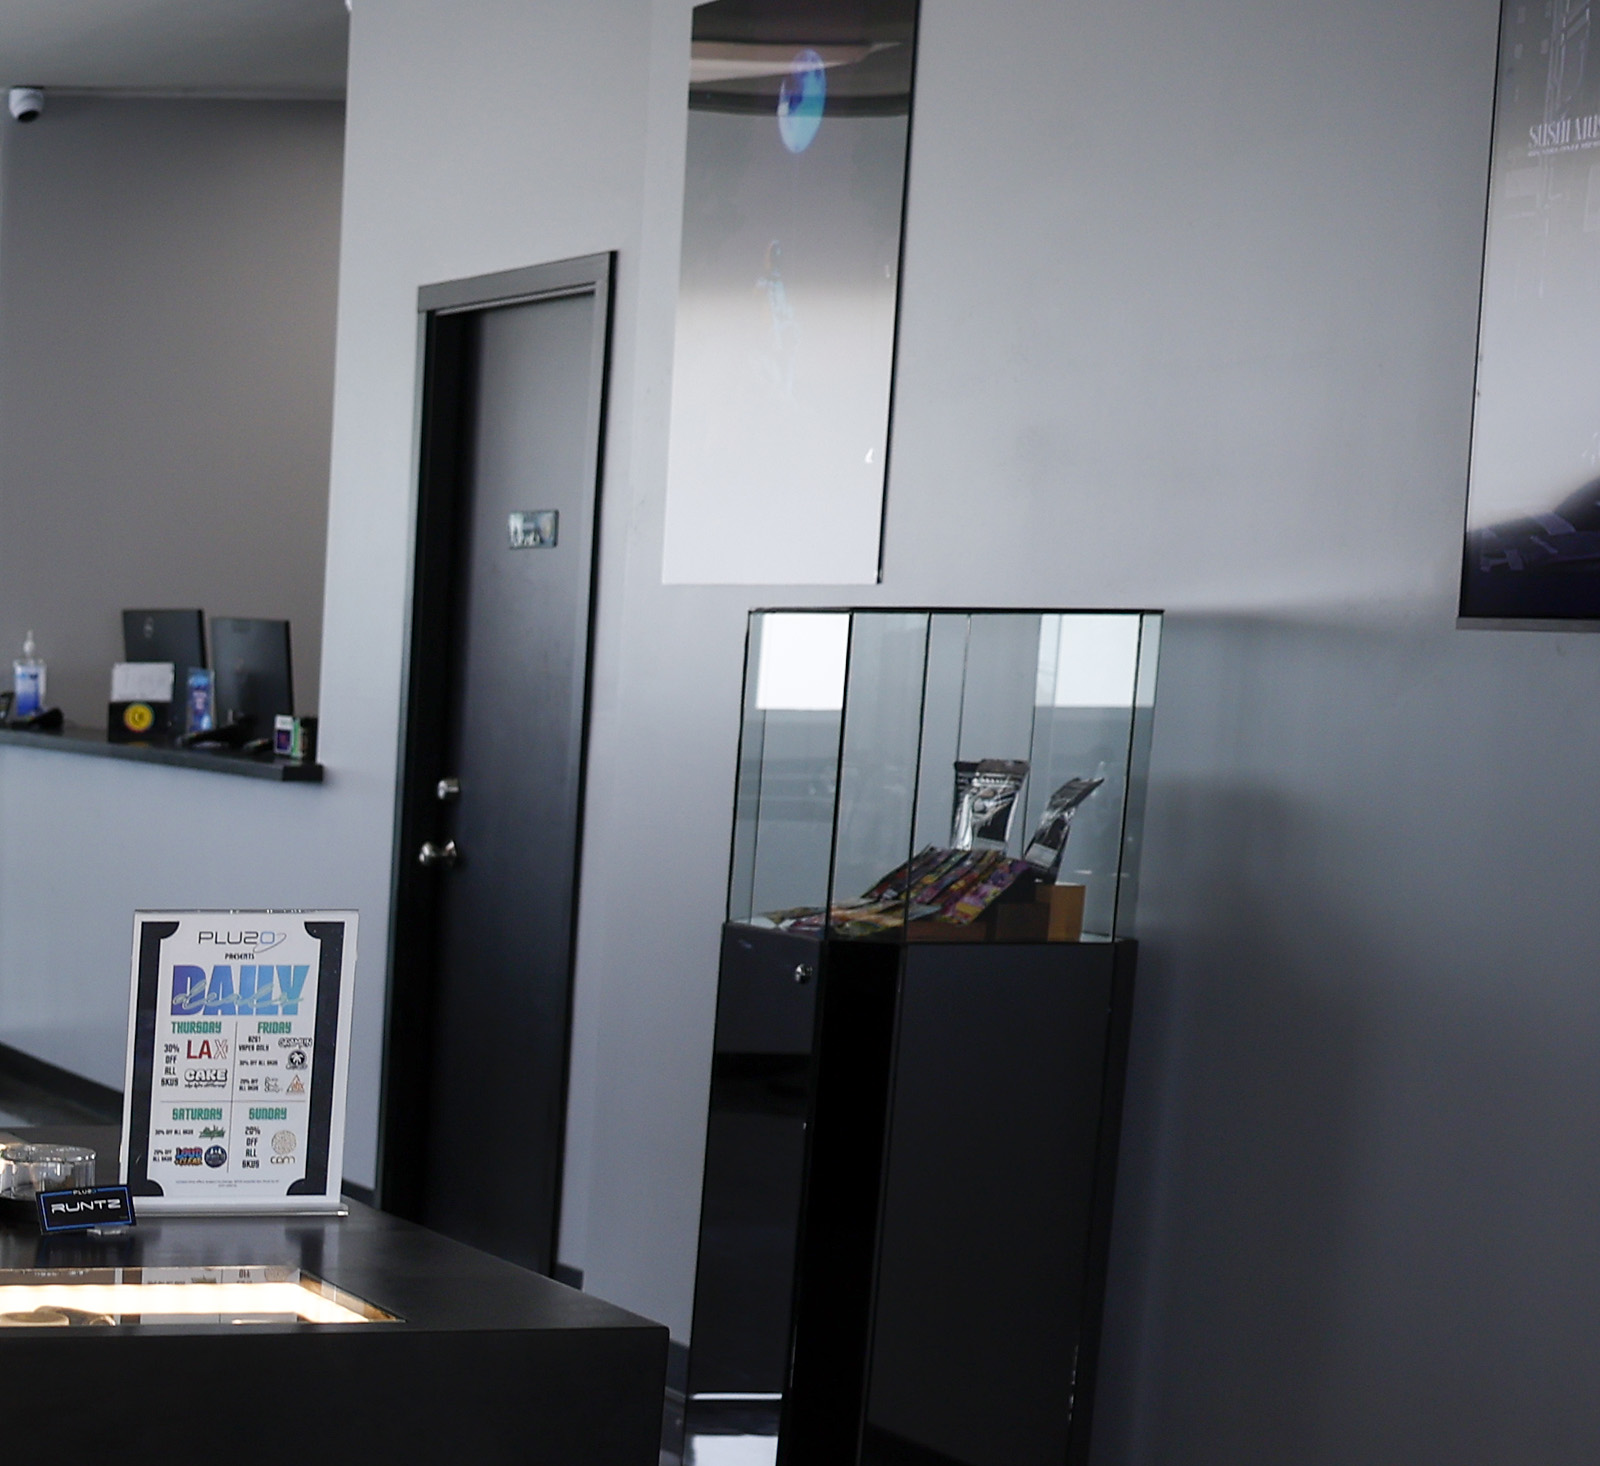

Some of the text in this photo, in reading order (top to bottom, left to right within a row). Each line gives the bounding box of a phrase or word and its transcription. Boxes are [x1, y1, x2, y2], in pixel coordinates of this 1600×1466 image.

[170, 965, 311, 1016] DAILY
[171, 1021, 222, 1034] THURSDAY
[257, 1021, 292, 1034] FRIDAY
[164, 1043, 180, 1053] 30%
[165, 1055, 177, 1065] OFF
[164, 1066, 176, 1076] ALL
[184, 1068, 228, 1082] CAKE
[172, 1107, 223, 1120] SATURDAY
[249, 1107, 287, 1120] SUNDAY
[244, 1126, 261, 1136] 20%
[246, 1137, 258, 1146] OFF
[245, 1148, 257, 1157] ALL
[51, 1198, 121, 1215] RUNTZ
